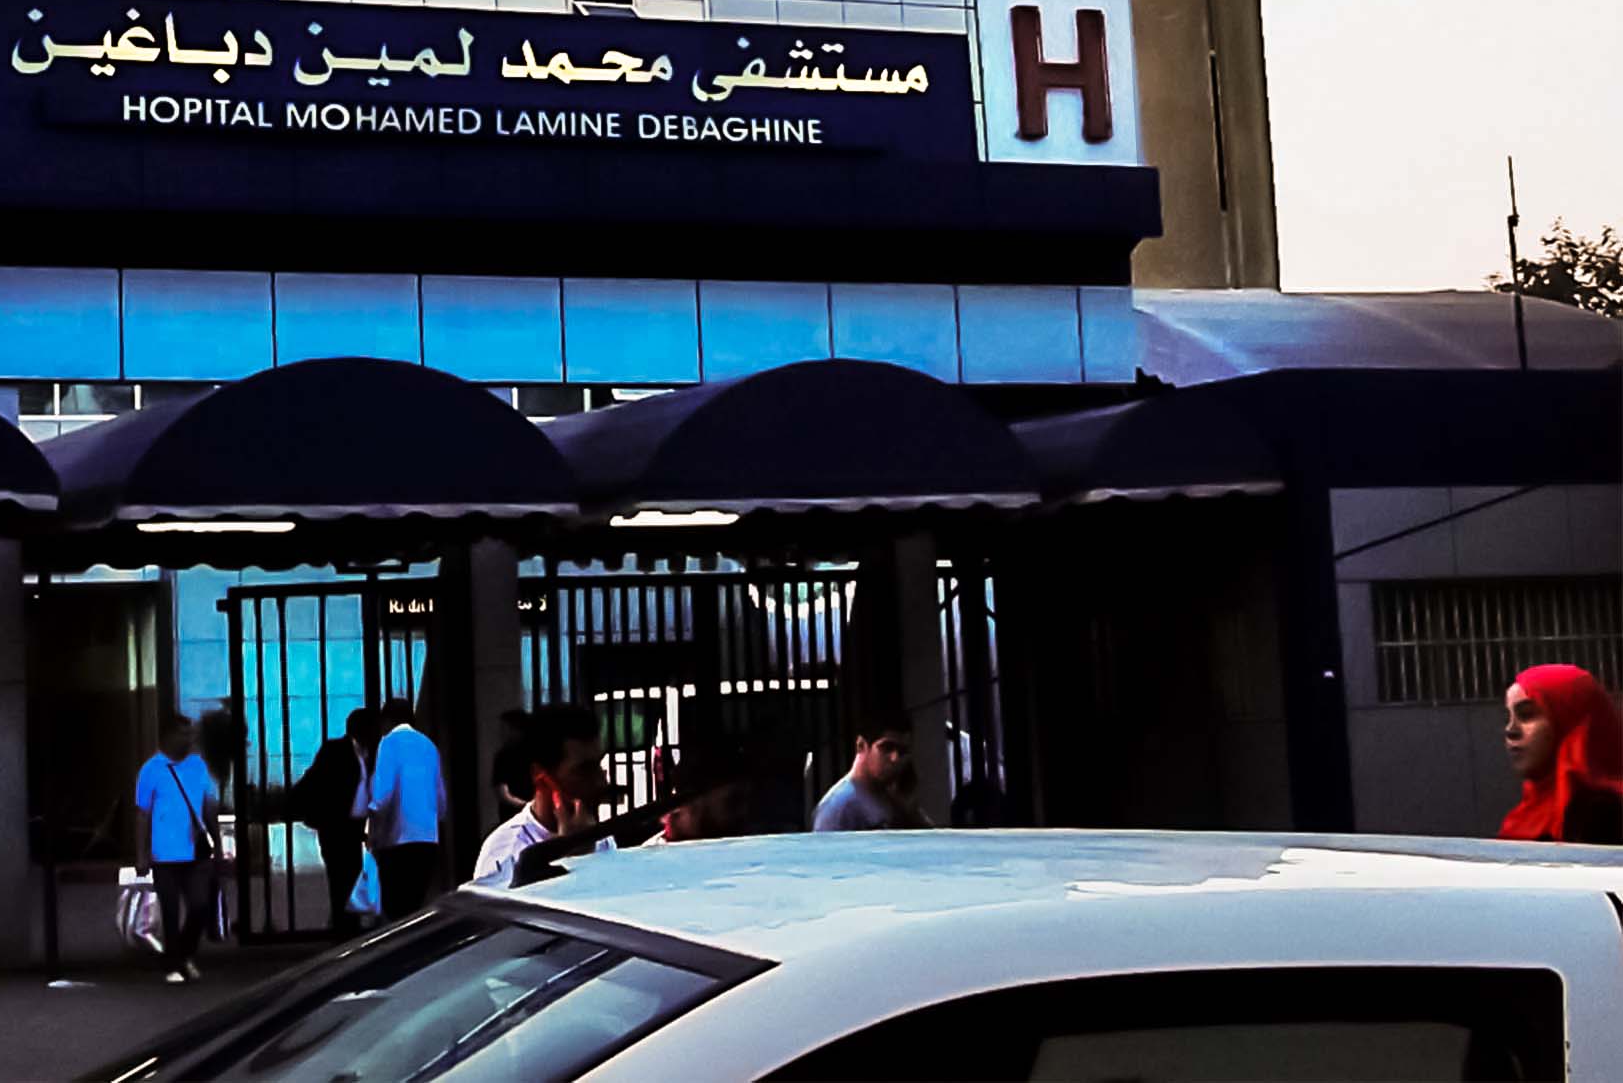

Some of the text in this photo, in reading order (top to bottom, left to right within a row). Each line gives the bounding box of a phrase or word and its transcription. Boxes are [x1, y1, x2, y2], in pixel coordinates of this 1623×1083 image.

[11, 8, 274, 83] دباغين
[293, 22, 475, 87] لمين
[501, 39, 673, 84] محمد
[1010, 5, 1113, 144] H
[122, 95, 824, 145] HOPITAL MOHAMED LAMINE DEBAGHINE
